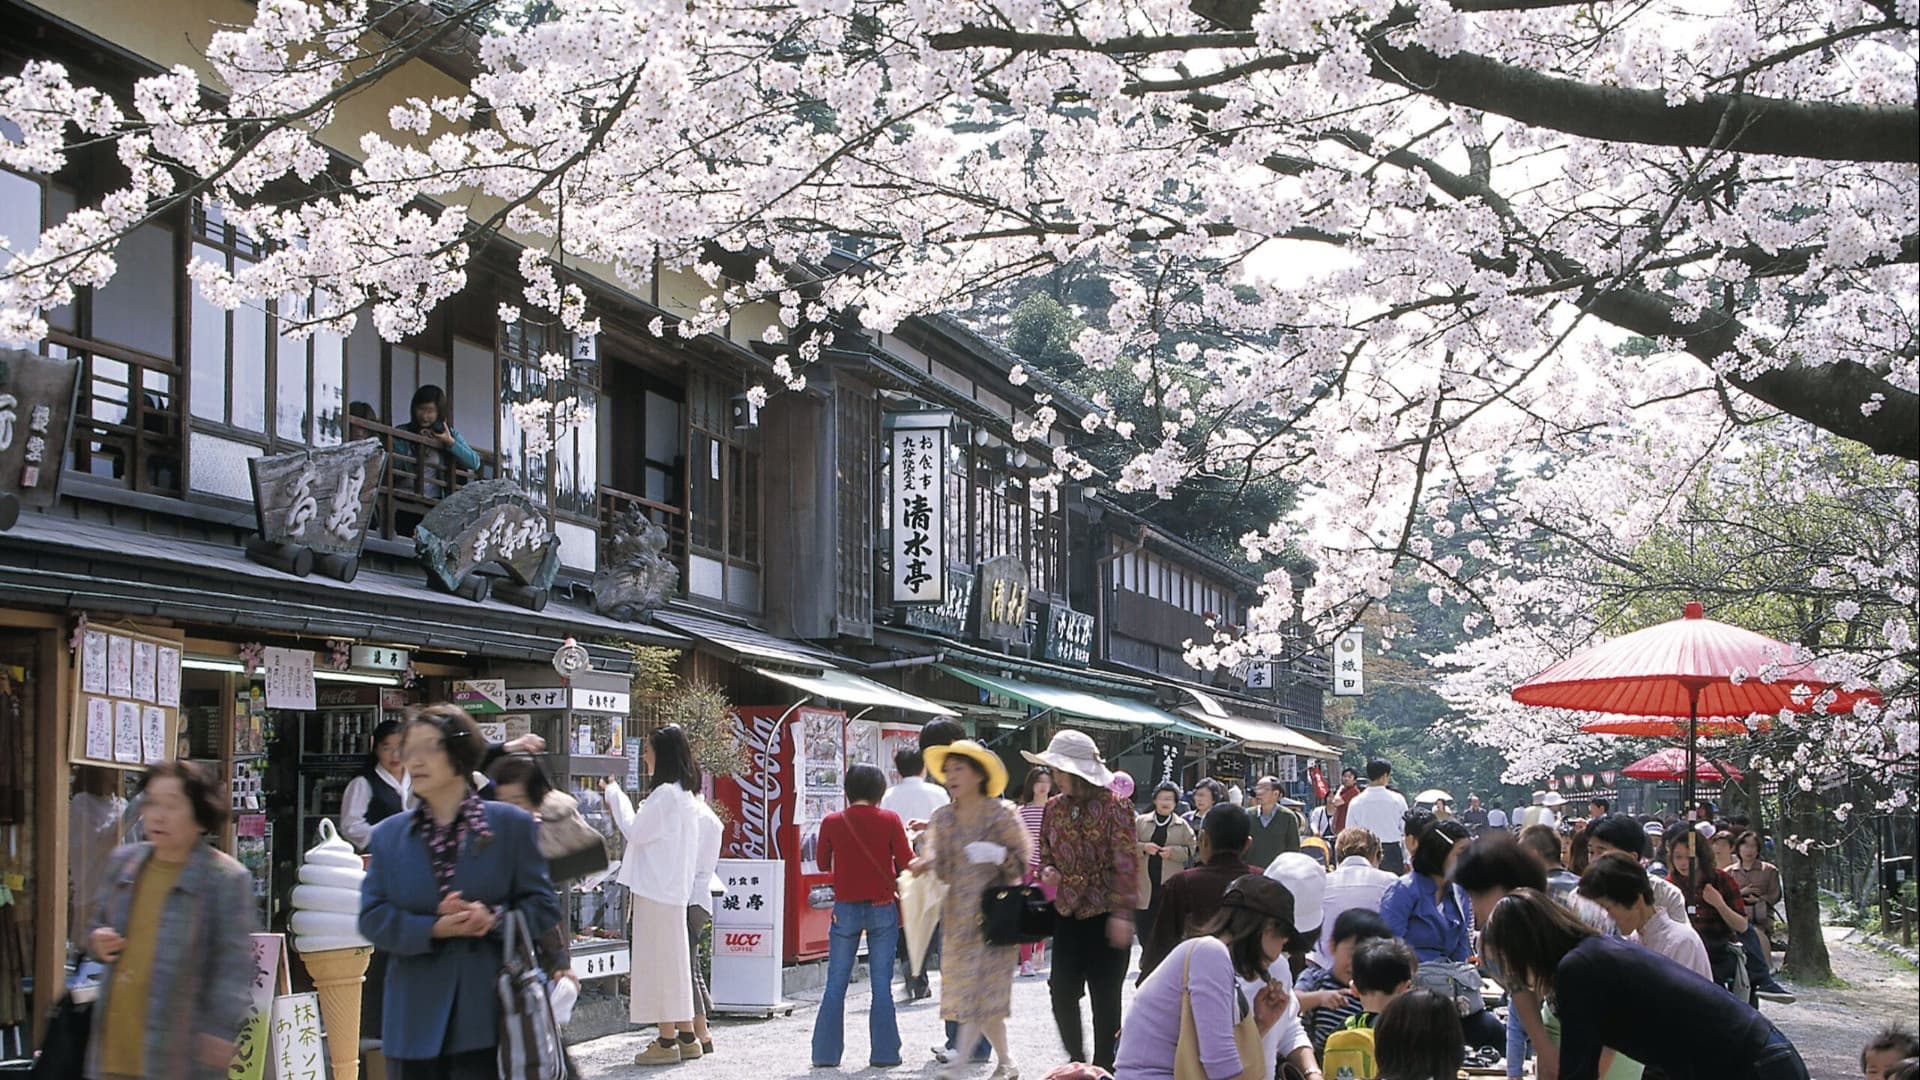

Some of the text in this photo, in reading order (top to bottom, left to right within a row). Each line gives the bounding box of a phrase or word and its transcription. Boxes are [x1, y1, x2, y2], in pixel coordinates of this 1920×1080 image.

[919, 435, 933, 490] お食事
[903, 494, 933, 594] 清水亭
[1342, 658, 1357, 688] 織田
[729, 876, 759, 886] お食事
[725, 933, 762, 946] UCC
